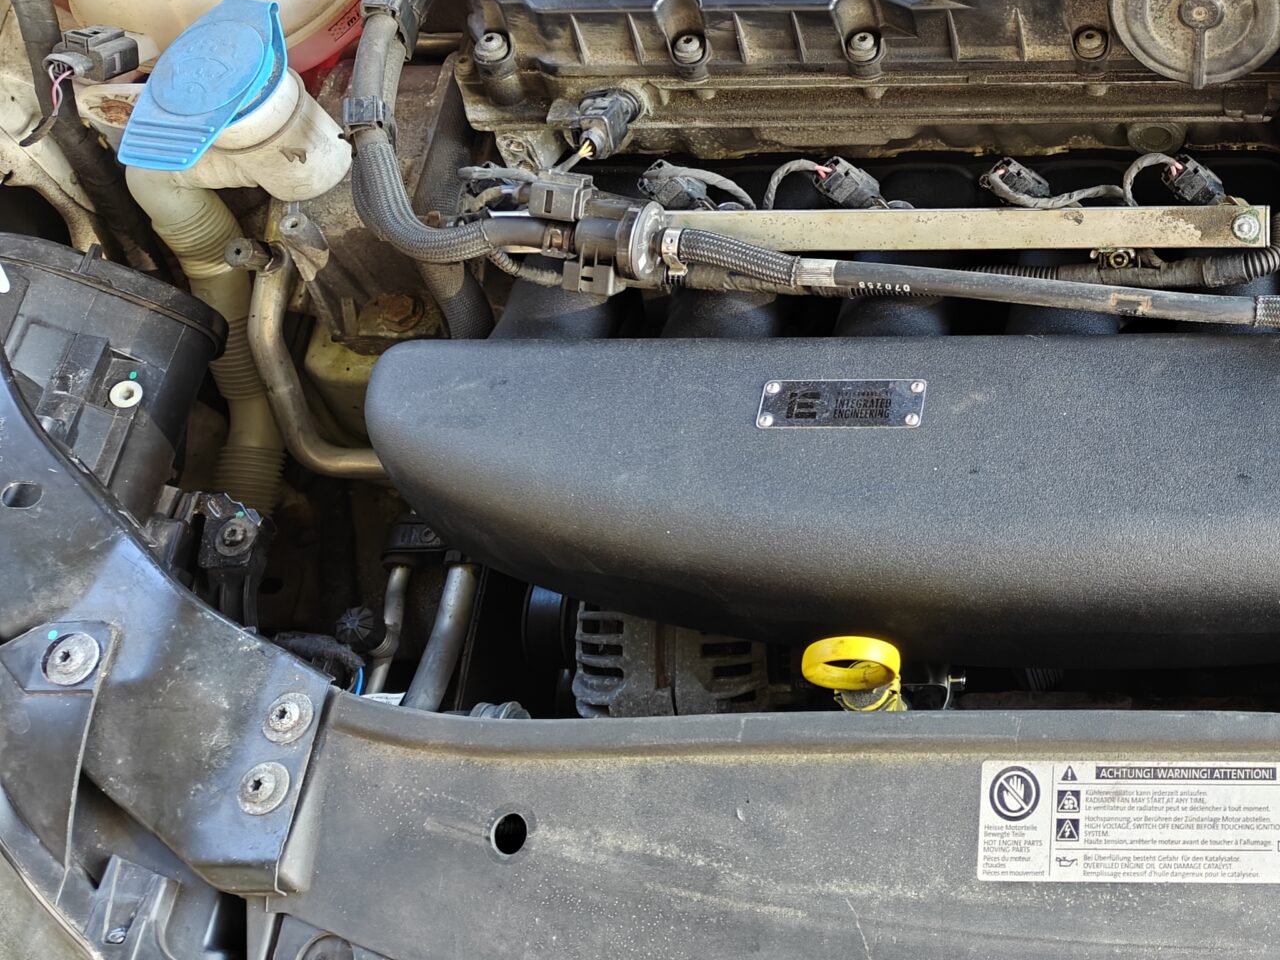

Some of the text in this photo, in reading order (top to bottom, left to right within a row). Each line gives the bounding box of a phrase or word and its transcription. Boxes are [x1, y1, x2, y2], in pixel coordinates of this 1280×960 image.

[834, 399, 892, 409] INTEGRATED
[832, 409, 890, 419] ENGINEERING
[1100, 768, 1273, 779] ACHTUNG! WARNING! ATTENTION!
